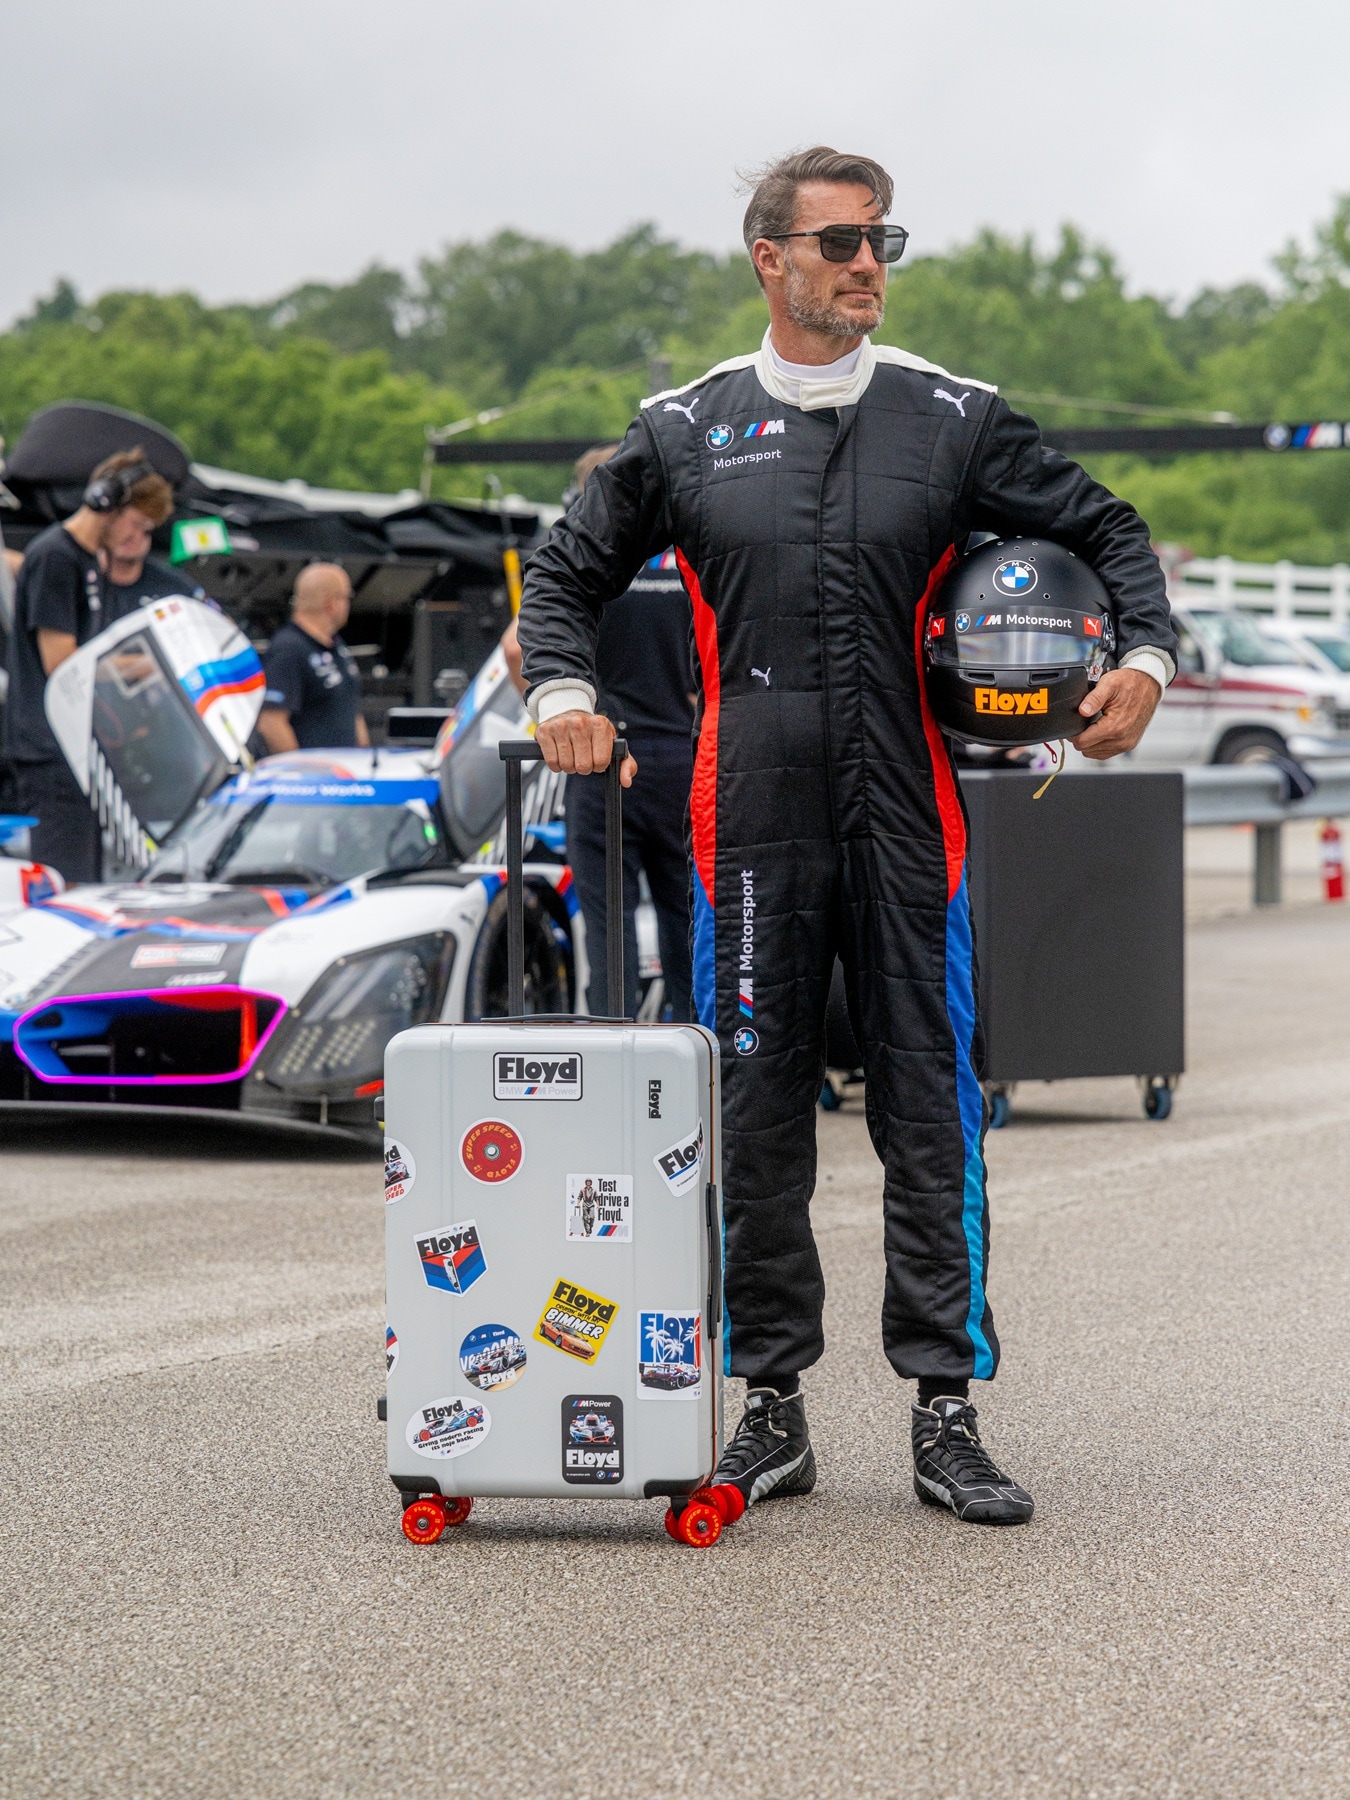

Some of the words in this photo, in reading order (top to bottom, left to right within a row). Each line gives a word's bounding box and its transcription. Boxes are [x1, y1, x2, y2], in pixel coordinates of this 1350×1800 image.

[713, 449, 782, 470] Motorsport
[1006, 614, 1072, 629] Motorsport
[975, 687, 1048, 715] Floyd
[739, 870, 756, 970] Motorsport
[499, 1057, 577, 1084] Floyd
[499, 1086, 523, 1095] BMW
[548, 1086, 578, 1095] Power
[648, 1079, 661, 1119] Floyd
[466, 1129, 481, 1160] SUPER
[482, 1124, 514, 1139] SPEED
[486, 1158, 516, 1178] FLOYD
[597, 1178, 617, 1192] Test
[598, 1193, 622, 1207] drive
[623, 1196, 629, 1207] a
[597, 1207, 624, 1223] Floyd.
[416, 1226, 480, 1260] Floyd
[553, 1281, 616, 1324] Floyd
[545, 1307, 605, 1340] BIMMER
[479, 1368, 517, 1387] Floyd
[422, 1399, 464, 1423] Floyd
[418, 1439, 439, 1449] Giving
[440, 1432, 462, 1443] modern
[463, 1426, 484, 1436] racing
[456, 1435, 474, 1444] back.
[566, 1449, 620, 1468] Floyd
[413, 1506, 436, 1516] FLOYD
[711, 1514, 719, 1537] FLOYD
